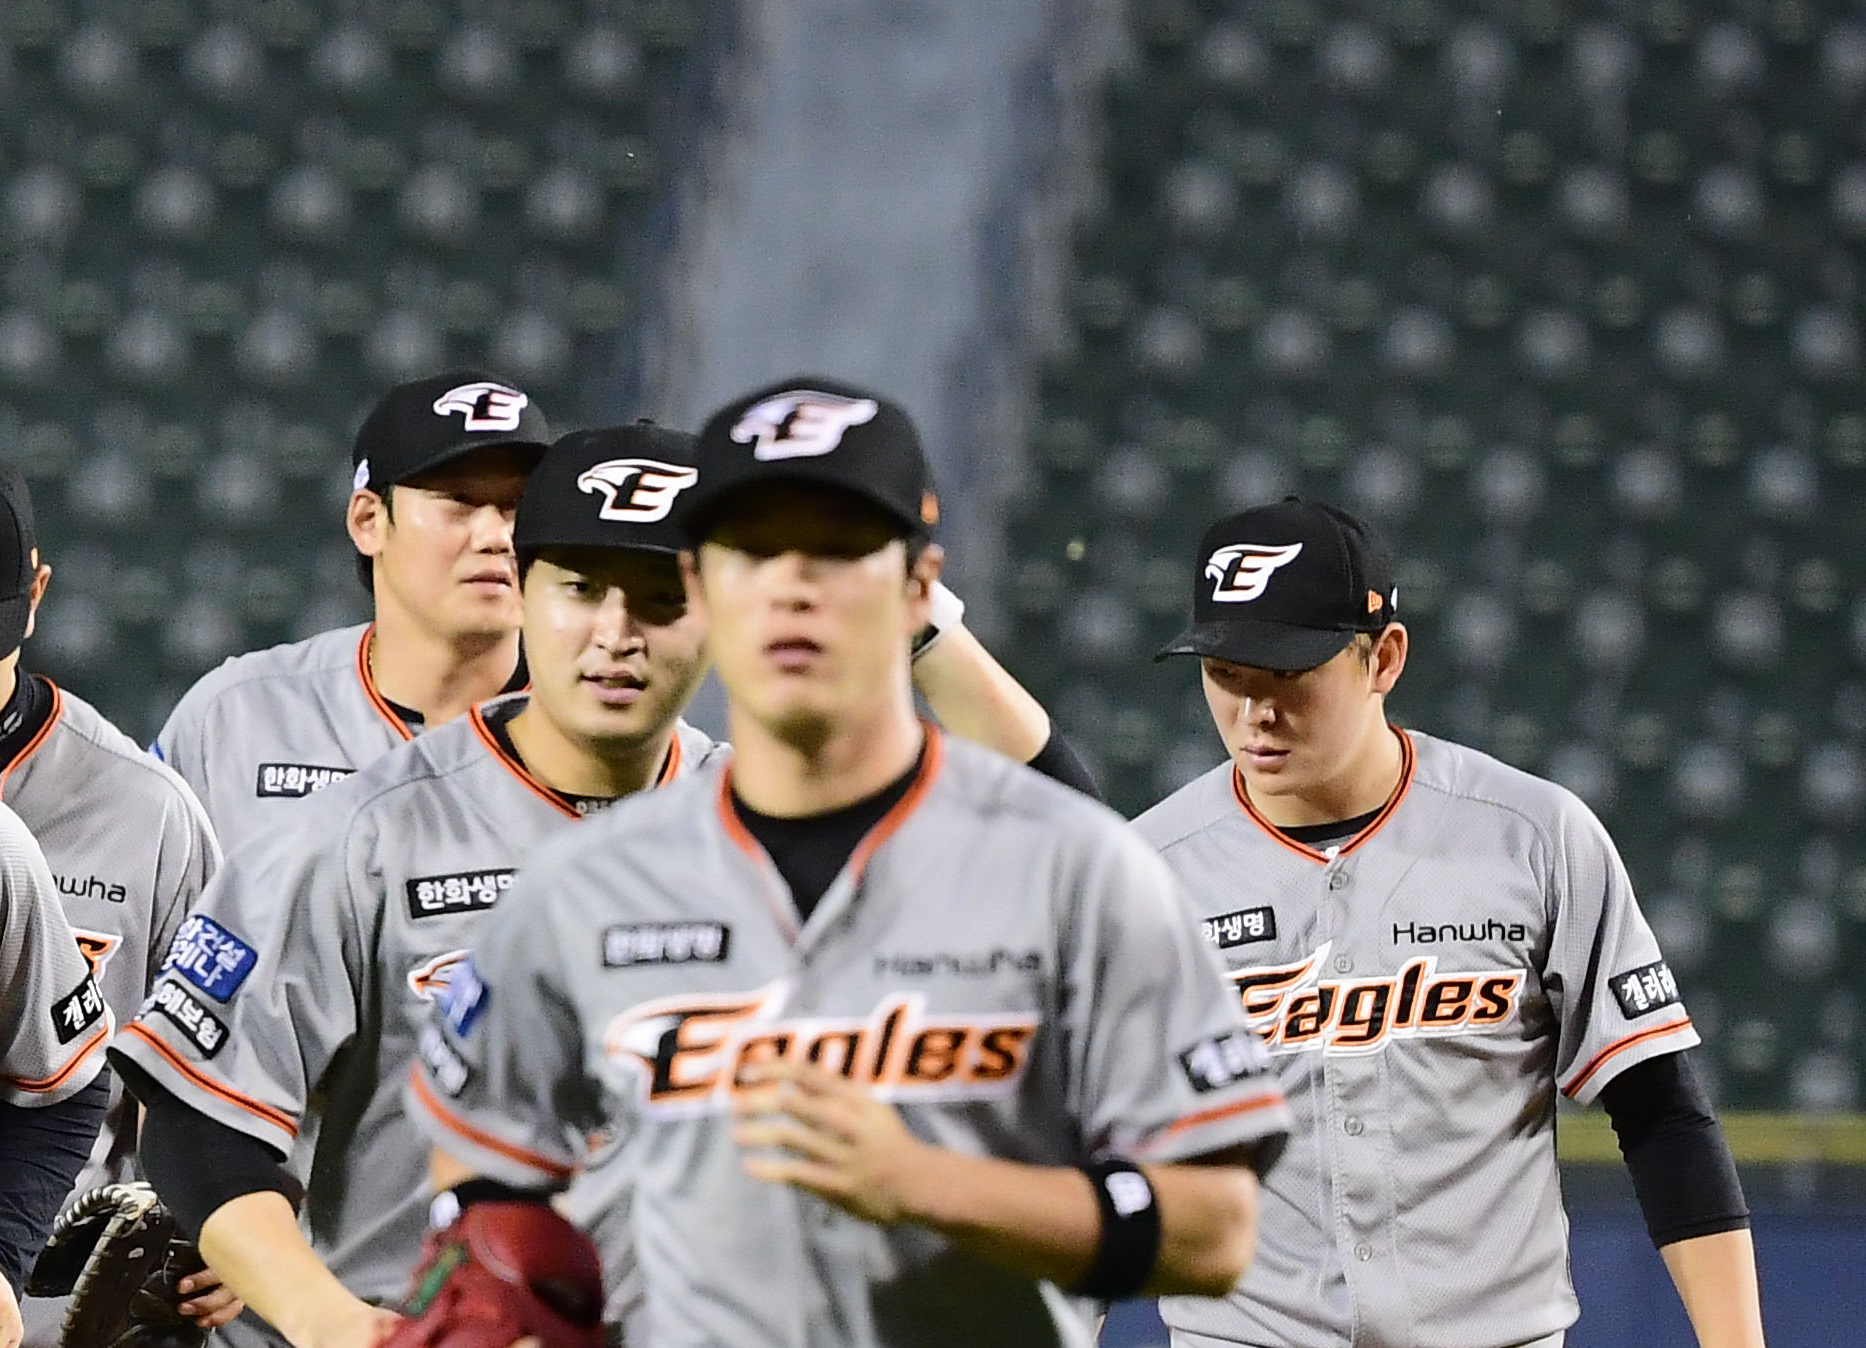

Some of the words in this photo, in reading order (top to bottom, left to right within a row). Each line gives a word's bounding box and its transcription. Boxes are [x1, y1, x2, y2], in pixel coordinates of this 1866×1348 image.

[49, 872, 127, 903] wha
[1200, 910, 1265, 944] 화생명
[1392, 918, 1525, 945] Hanwha
